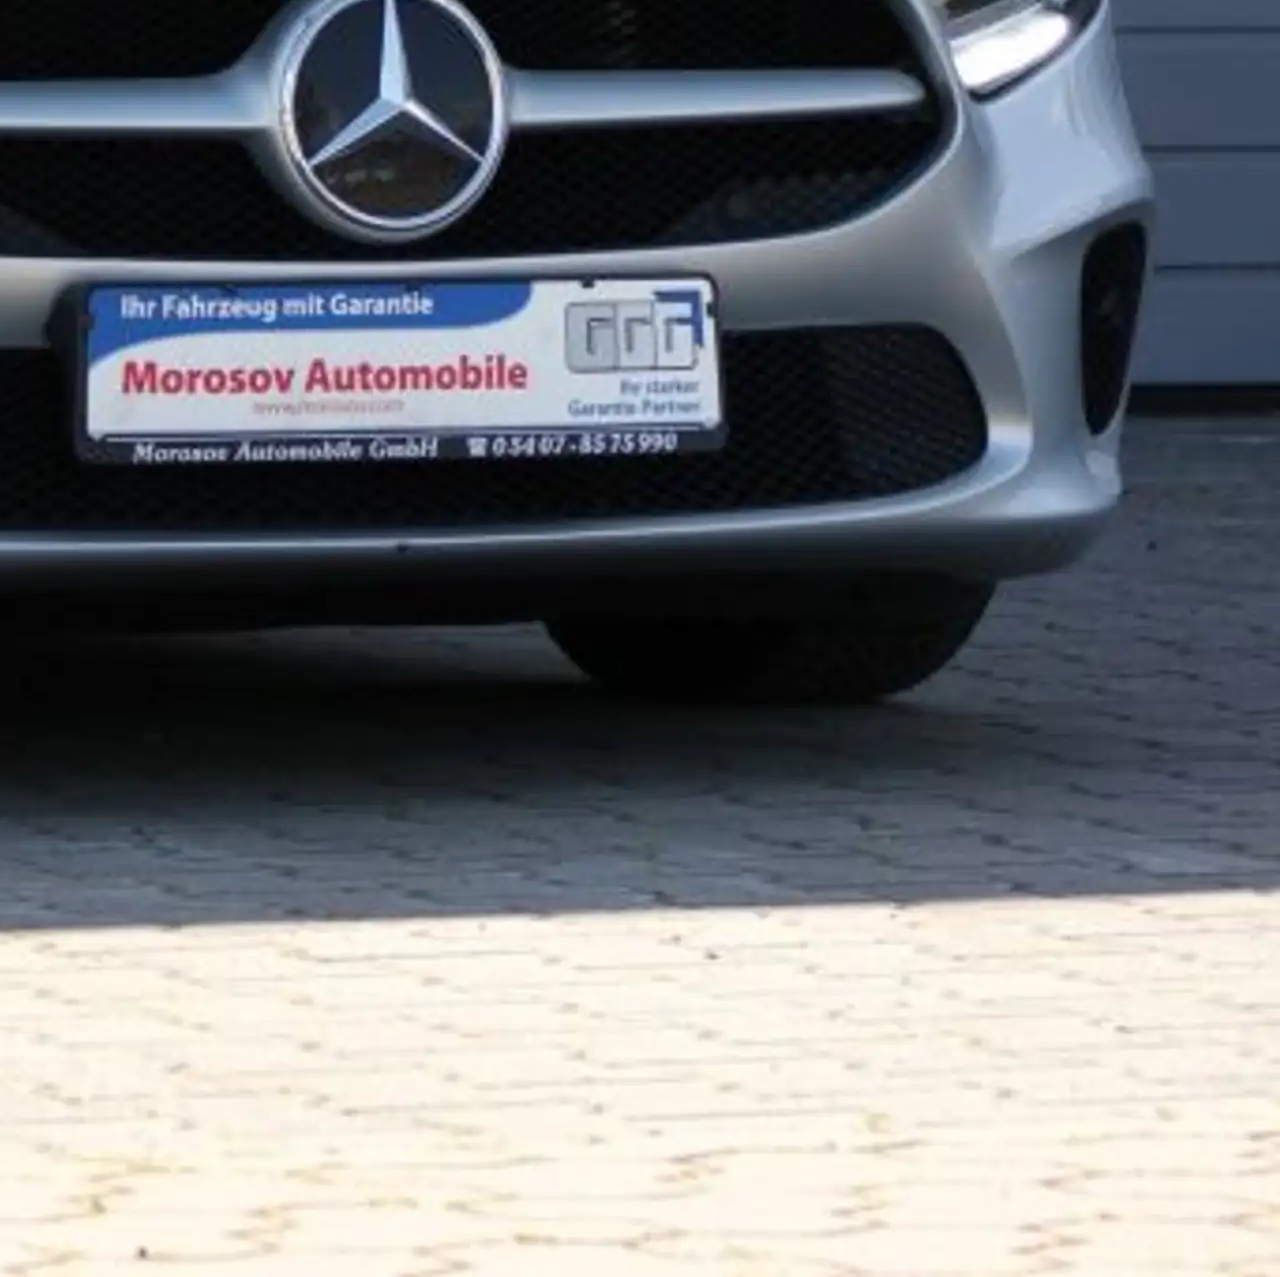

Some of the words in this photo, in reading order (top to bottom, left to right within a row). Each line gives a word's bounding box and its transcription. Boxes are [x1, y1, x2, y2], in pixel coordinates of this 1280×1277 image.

[121, 294, 157, 318] Ihr
[162, 294, 276, 323] Fahrzeug
[282, 294, 324, 315] mit
[329, 292, 434, 315] Garantie
[122, 360, 294, 394] Morosov
[304, 356, 528, 393] Automobile
[235, 440, 363, 462] Automobile
[369, 437, 438, 458] GmbH
